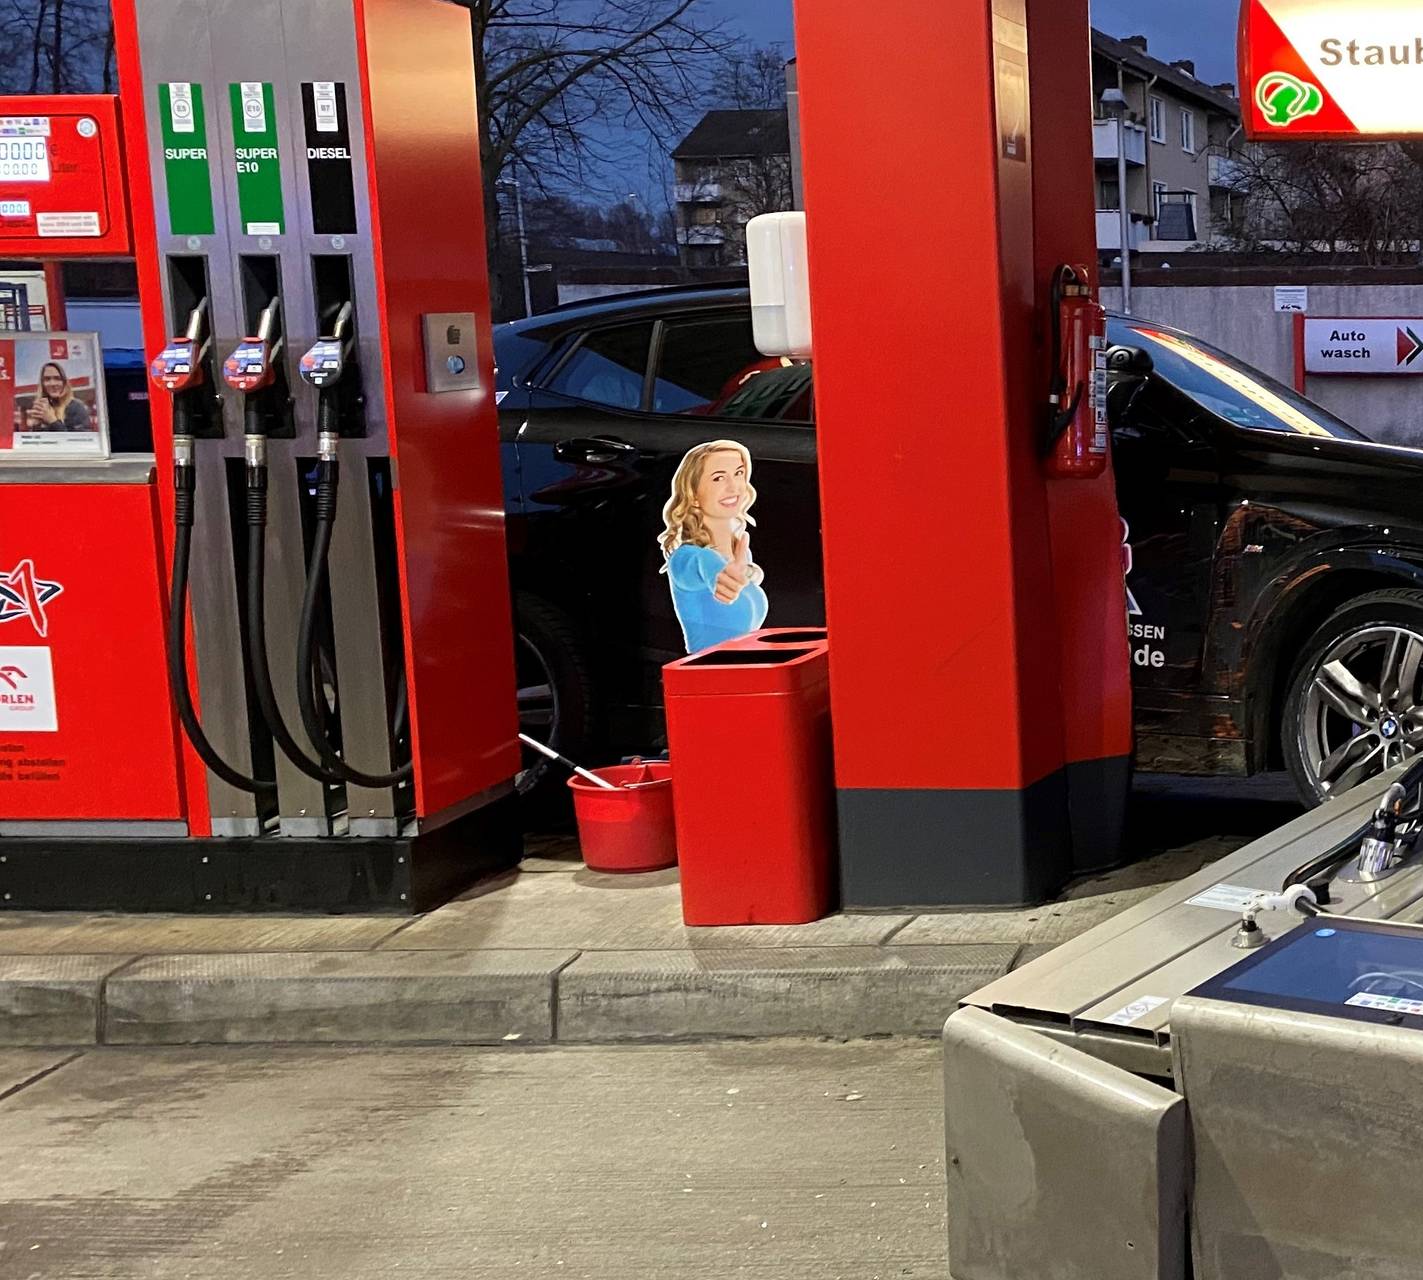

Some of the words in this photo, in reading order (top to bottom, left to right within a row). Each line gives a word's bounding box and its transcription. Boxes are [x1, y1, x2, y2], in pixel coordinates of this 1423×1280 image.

[247, 104, 260, 112] E10
[165, 148, 207, 160] SUPER
[235, 147, 278, 160] SUPER
[307, 147, 351, 159] DIESEL
[237, 162, 259, 173] E10
[1329, 330, 1366, 342] Auto
[1320, 347, 1371, 358] wasch
[1134, 644, 1165, 667] de
[0, 694, 34, 704] RLEN
